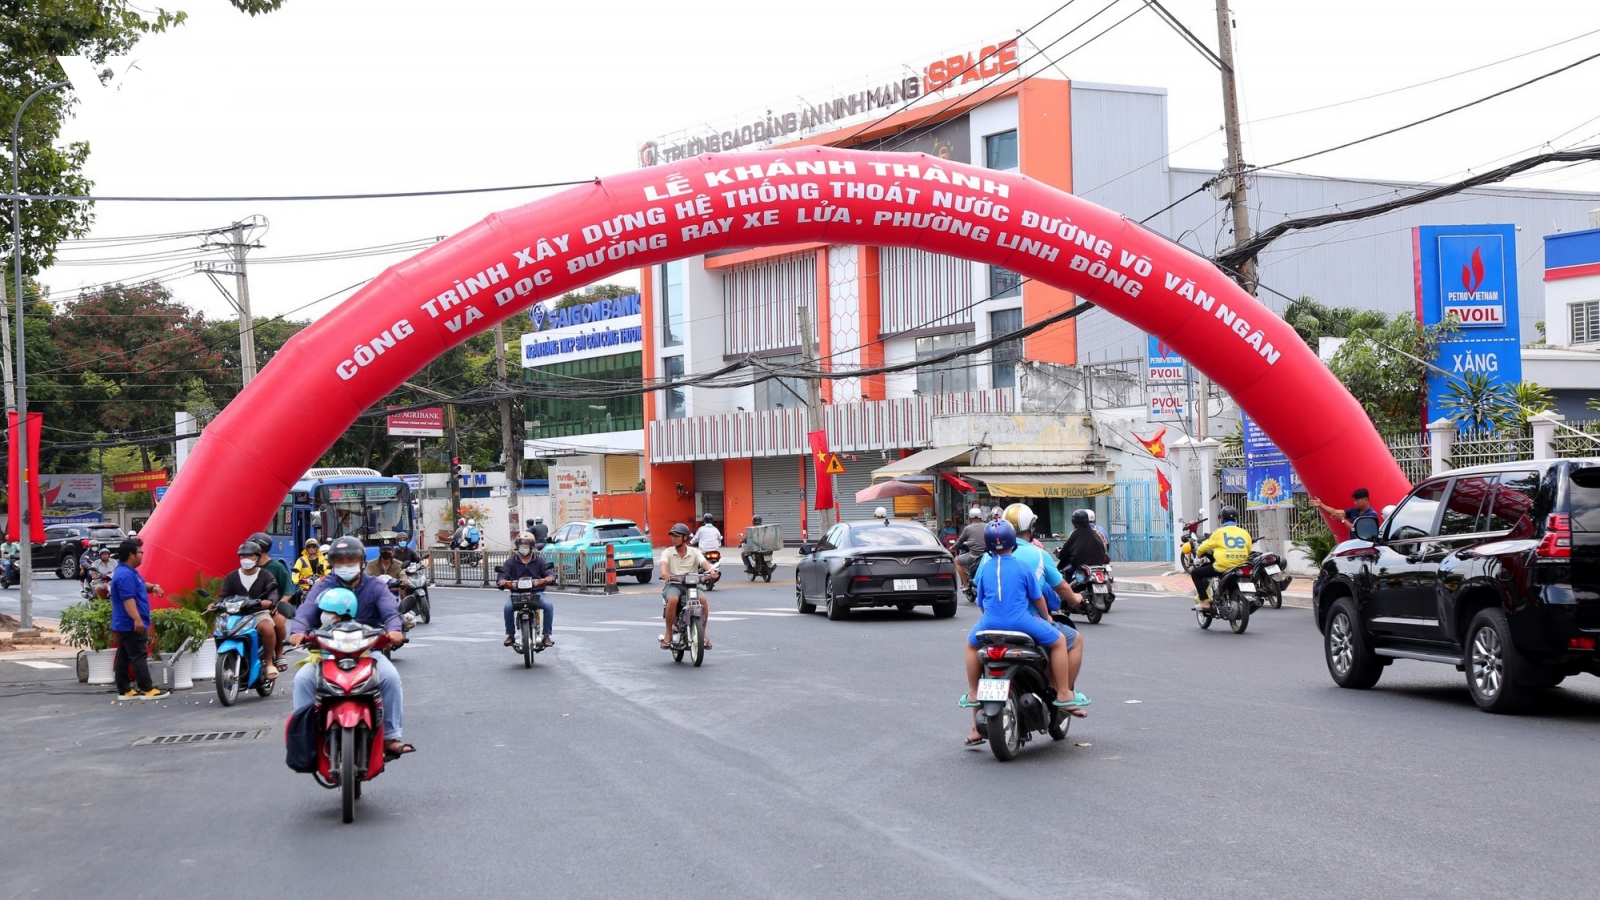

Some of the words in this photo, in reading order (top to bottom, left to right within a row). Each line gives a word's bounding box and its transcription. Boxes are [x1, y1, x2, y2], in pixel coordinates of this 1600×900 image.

[721, 125, 752, 151] CAO
[800, 104, 823, 131] AN
[824, 91, 867, 121] NINH
[867, 76, 920, 111] MẠNG
[922, 38, 1018, 96] iSPACE
[643, 172, 693, 201] LỄ
[704, 158, 857, 187] KHÁNH
[868, 162, 1010, 199] THÀNH
[335, 318, 415, 381] CÔNG
[420, 261, 510, 319] TRÌNH
[512, 233, 570, 270] XÂY
[581, 207, 667, 245] DỰNG
[674, 194, 714, 220] HỆ
[721, 178, 819, 209] THỐNG
[829, 180, 921, 206] THOÁT
[932, 190, 1010, 223] NƯỚC
[1020, 209, 1113, 260] ĐƯỜNG
[1119, 249, 1153, 278] VÕ
[1164, 271, 1216, 313] VĂN
[1214, 305, 1282, 366] NGÂN
[444, 305, 485, 334] VÀ
[494, 268, 553, 308] DỌC
[566, 232, 669, 276] ĐƯỜNG
[681, 216, 735, 242] RAY
[742, 209, 780, 230] XE
[873, 210, 990, 243] PHƯỜNG
[996, 231, 1061, 263] LINH
[1069, 253, 1145, 298] ĐÔNG
[1447, 290, 1499, 302] PETROVIETNAM
[547, 292, 641, 331] SAIGONBANK
[1453, 349, 1498, 373] XĂNG
[1150, 368, 1183, 379] PVOIL
[1152, 397, 1183, 408] PVOIL
[1161, 407, 1175, 415] Easy
[402, 411, 440, 420] AGRIBANK
[1042, 485, 1059, 496] VĂN
[1061, 486, 1088, 497] PHÒNG
[1223, 532, 1246, 549] be
